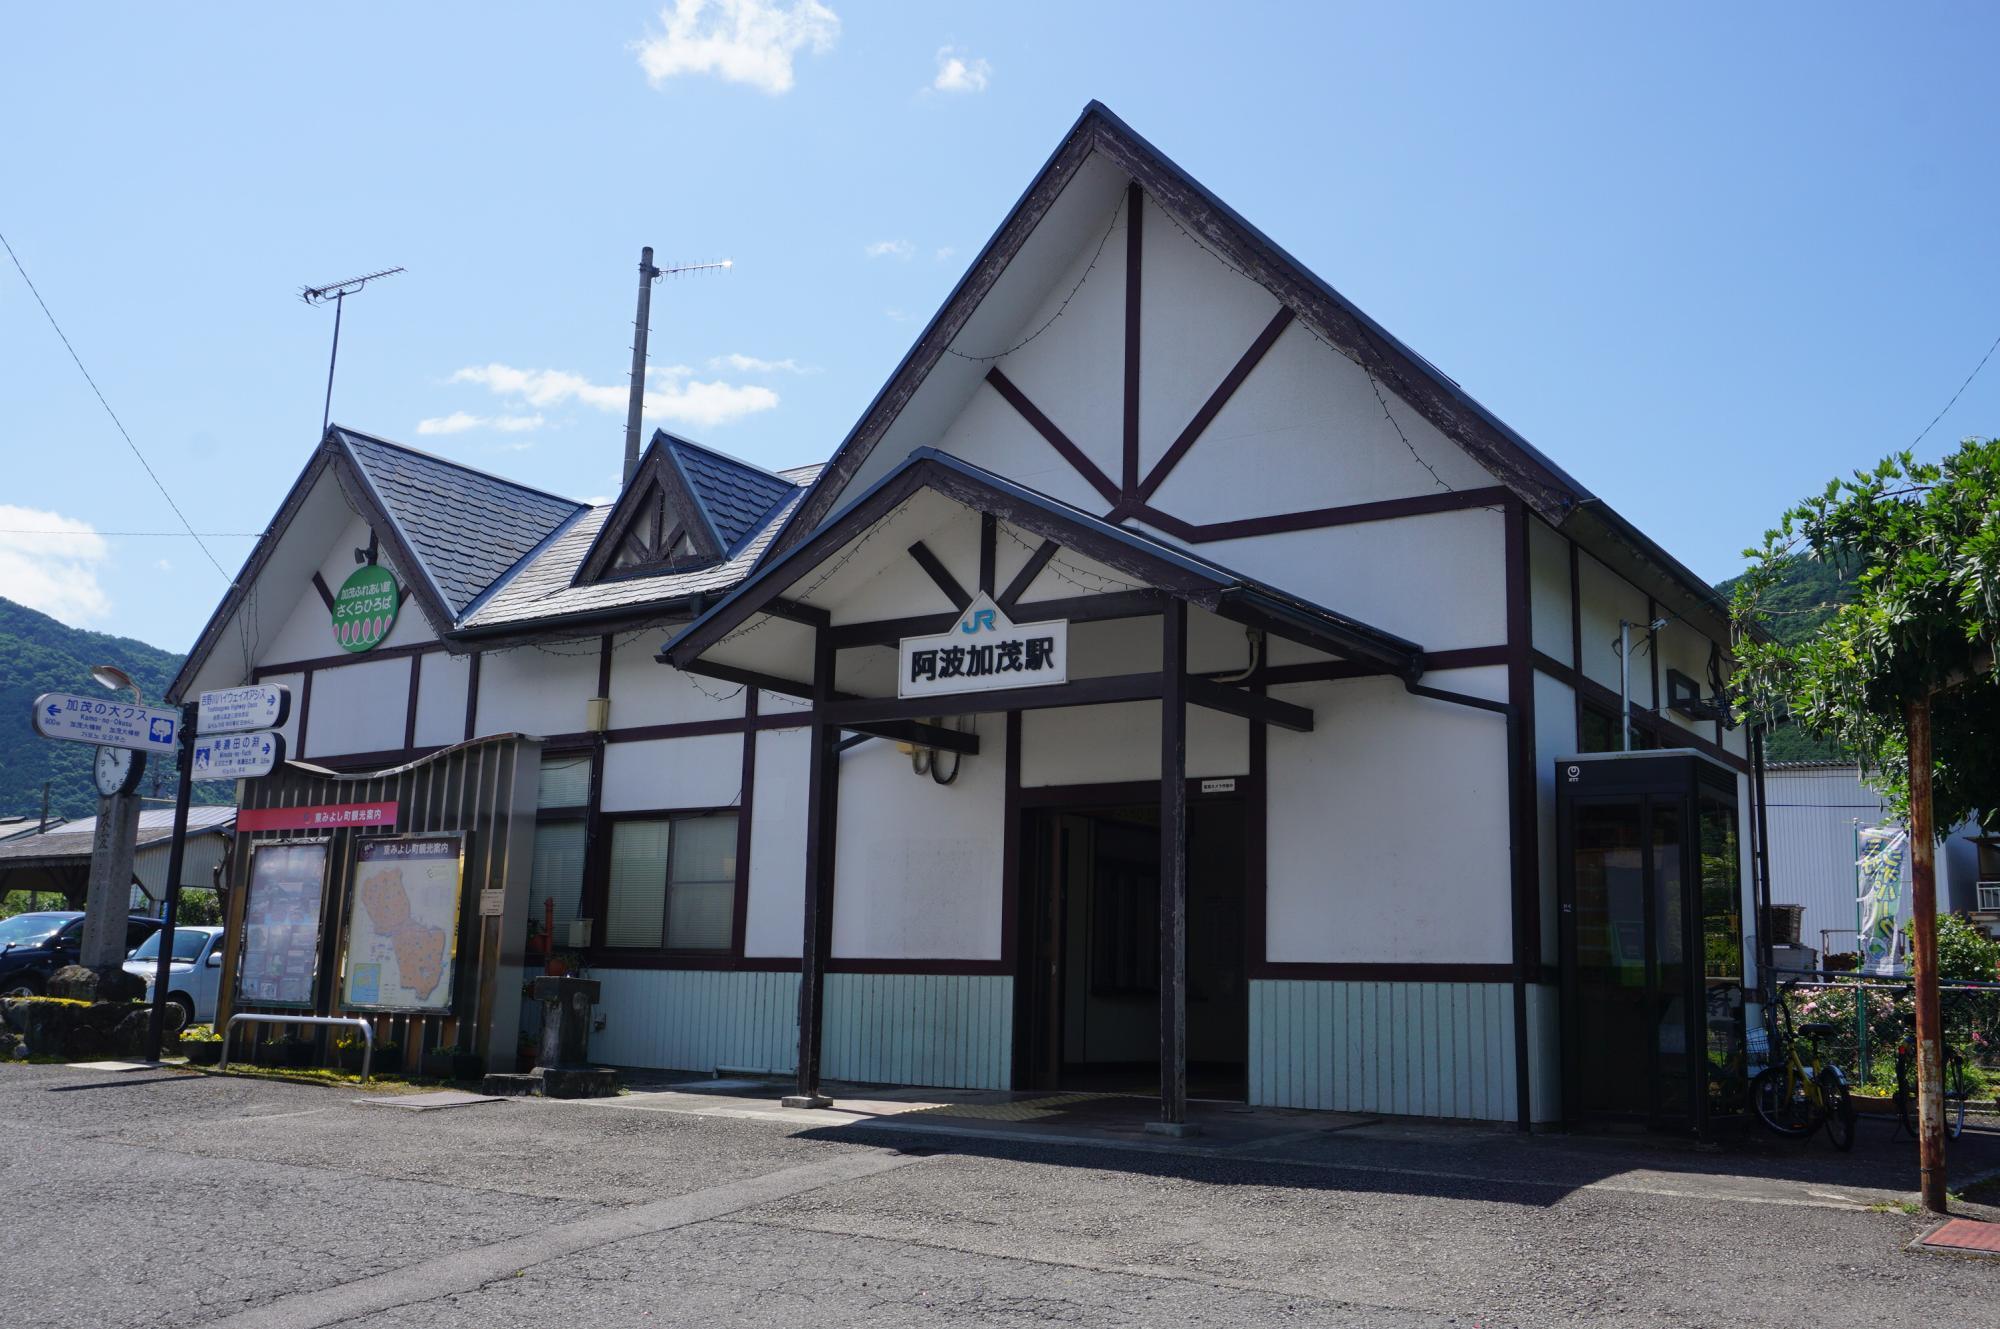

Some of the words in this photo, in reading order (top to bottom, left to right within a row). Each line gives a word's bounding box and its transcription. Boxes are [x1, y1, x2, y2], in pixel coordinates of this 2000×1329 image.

[336, 595, 392, 618] さくらひろば
[961, 608, 997, 635] JR
[910, 636, 1054, 683] 阿波加茂駅
[66, 699, 148, 722] 加茂の大クス
[314, 809, 382, 824] 東みよし町観光案内
[383, 842, 450, 855] 東みよし町観光案内
